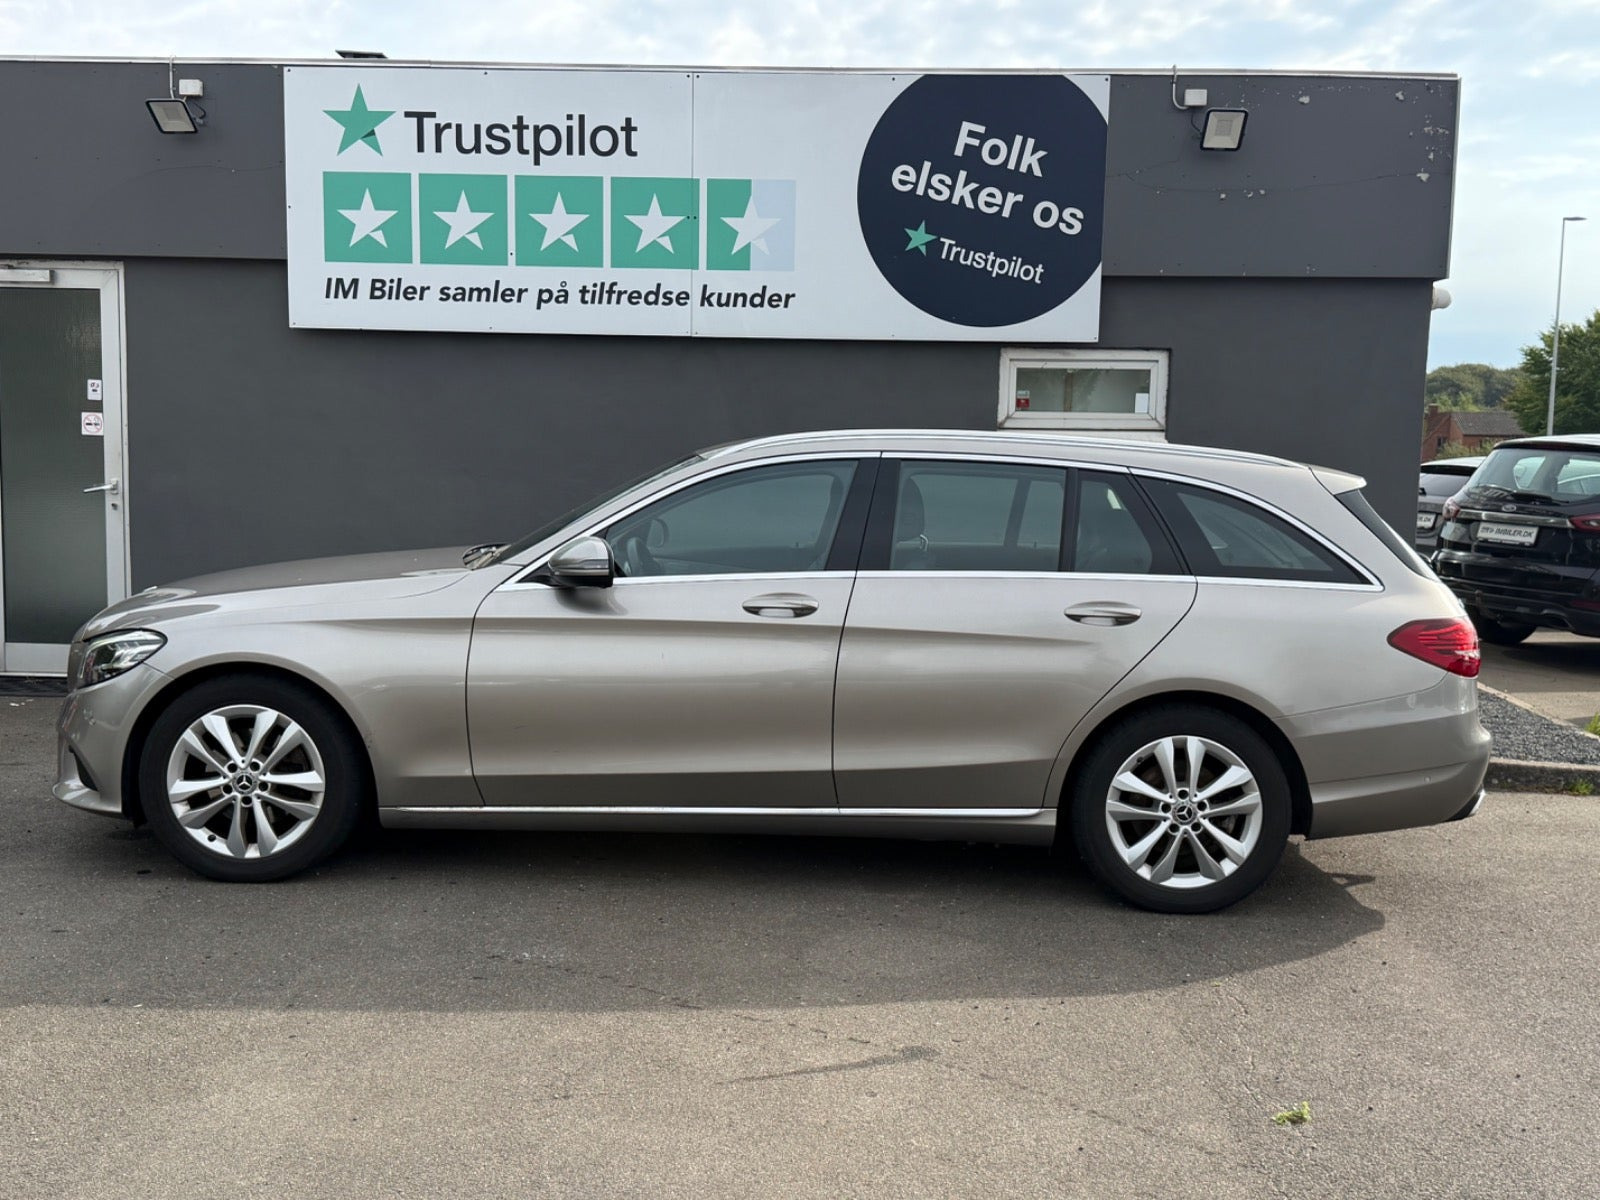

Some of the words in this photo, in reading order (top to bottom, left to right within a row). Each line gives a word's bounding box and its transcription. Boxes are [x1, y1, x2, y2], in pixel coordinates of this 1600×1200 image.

[403, 110, 638, 167] Trustpilot
[953, 120, 1048, 178] Folk
[891, 160, 1024, 218] elsker
[1032, 200, 1085, 235] os
[939, 237, 1045, 284] Trustpilot
[325, 277, 360, 300] IM
[369, 278, 431, 302] Biler
[438, 279, 529, 304] samler
[536, 280, 569, 310] på
[578, 281, 690, 307] tilfredse
[699, 284, 796, 309] kunder
